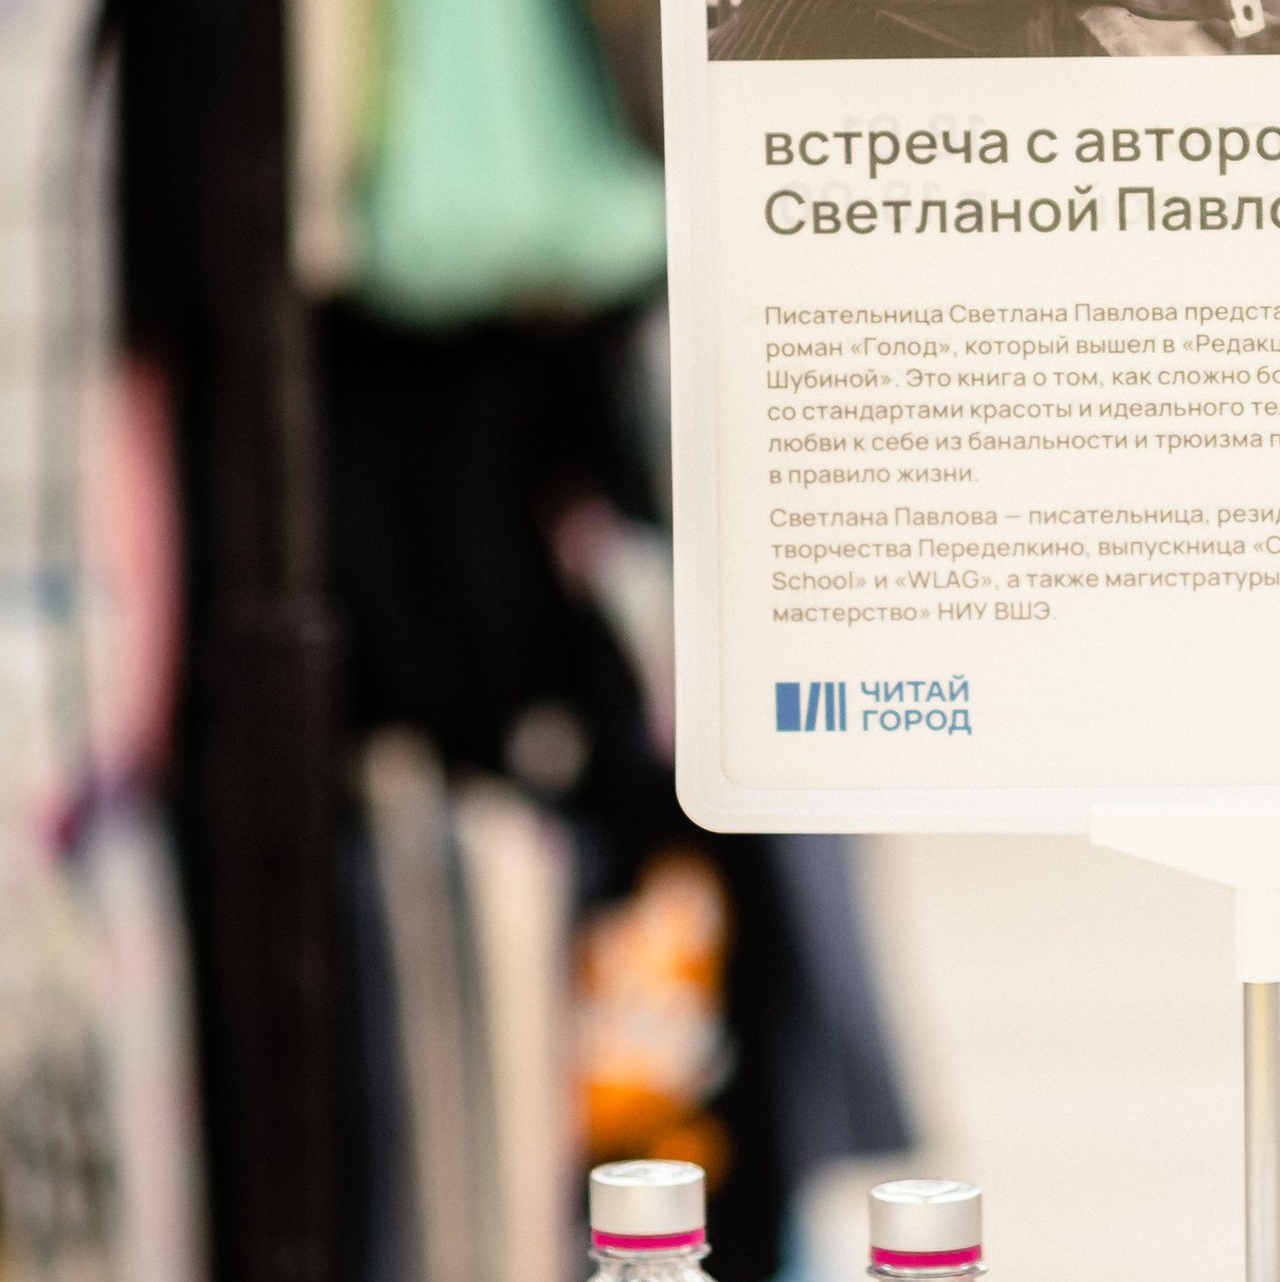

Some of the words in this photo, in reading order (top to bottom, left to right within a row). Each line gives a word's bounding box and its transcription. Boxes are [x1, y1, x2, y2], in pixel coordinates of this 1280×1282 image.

[765, 128, 1008, 180] встреча
[1027, 128, 1057, 164] с
[765, 184, 1098, 236] Светланой
[764, 305, 943, 326] Писательница
[949, 304, 1068, 324] Светлана
[1075, 302, 1178, 323] Павлова
[766, 341, 843, 363] роман
[965, 335, 1069, 358] который
[1076, 338, 1156, 355] вышел
[1163, 337, 1175, 353] в
[906, 367, 952, 388] Это
[958, 371, 1026, 388] книга
[1033, 371, 1047, 387] о
[1053, 371, 1103, 388] том,
[1112, 370, 1152, 386] как
[1157, 369, 1251, 386] сложно
[767, 405, 797, 422] со
[802, 403, 964, 425] стандартами
[970, 402, 1072, 423] красоты
[1079, 403, 1092, 418] и
[1099, 401, 1244, 420] идеального
[768, 433, 847, 454] любви
[853, 436, 866, 452] к
[871, 432, 929, 452] себе
[935, 435, 962, 452] из
[968, 430, 1128, 451] банальности
[1135, 434, 1148, 449] и
[1154, 432, 1263, 451] трюизма
[769, 468, 783, 485] в
[788, 467, 891, 490] правило
[897, 467, 977, 483] жизни.
[769, 507, 889, 529] Светлана
[894, 506, 997, 527] Павлова
[1029, 508, 1209, 526] писательница,
[770, 542, 912, 565] творчества
[918, 537, 1089, 563] Переделкино,
[1098, 539, 1245, 559] выпускница
[772, 570, 866, 592] School»
[874, 574, 888, 589] и
[1007, 573, 1020, 589] а
[1026, 572, 1099, 589] также
[1105, 566, 1280, 592] магистратуры
[772, 606, 930, 627] мастерство»
[938, 601, 987, 621] НИУ
[995, 600, 1055, 621] ВШЭ.
[861, 674, 969, 703] ЧИТАЙ
[862, 708, 972, 736] ГОРОД
